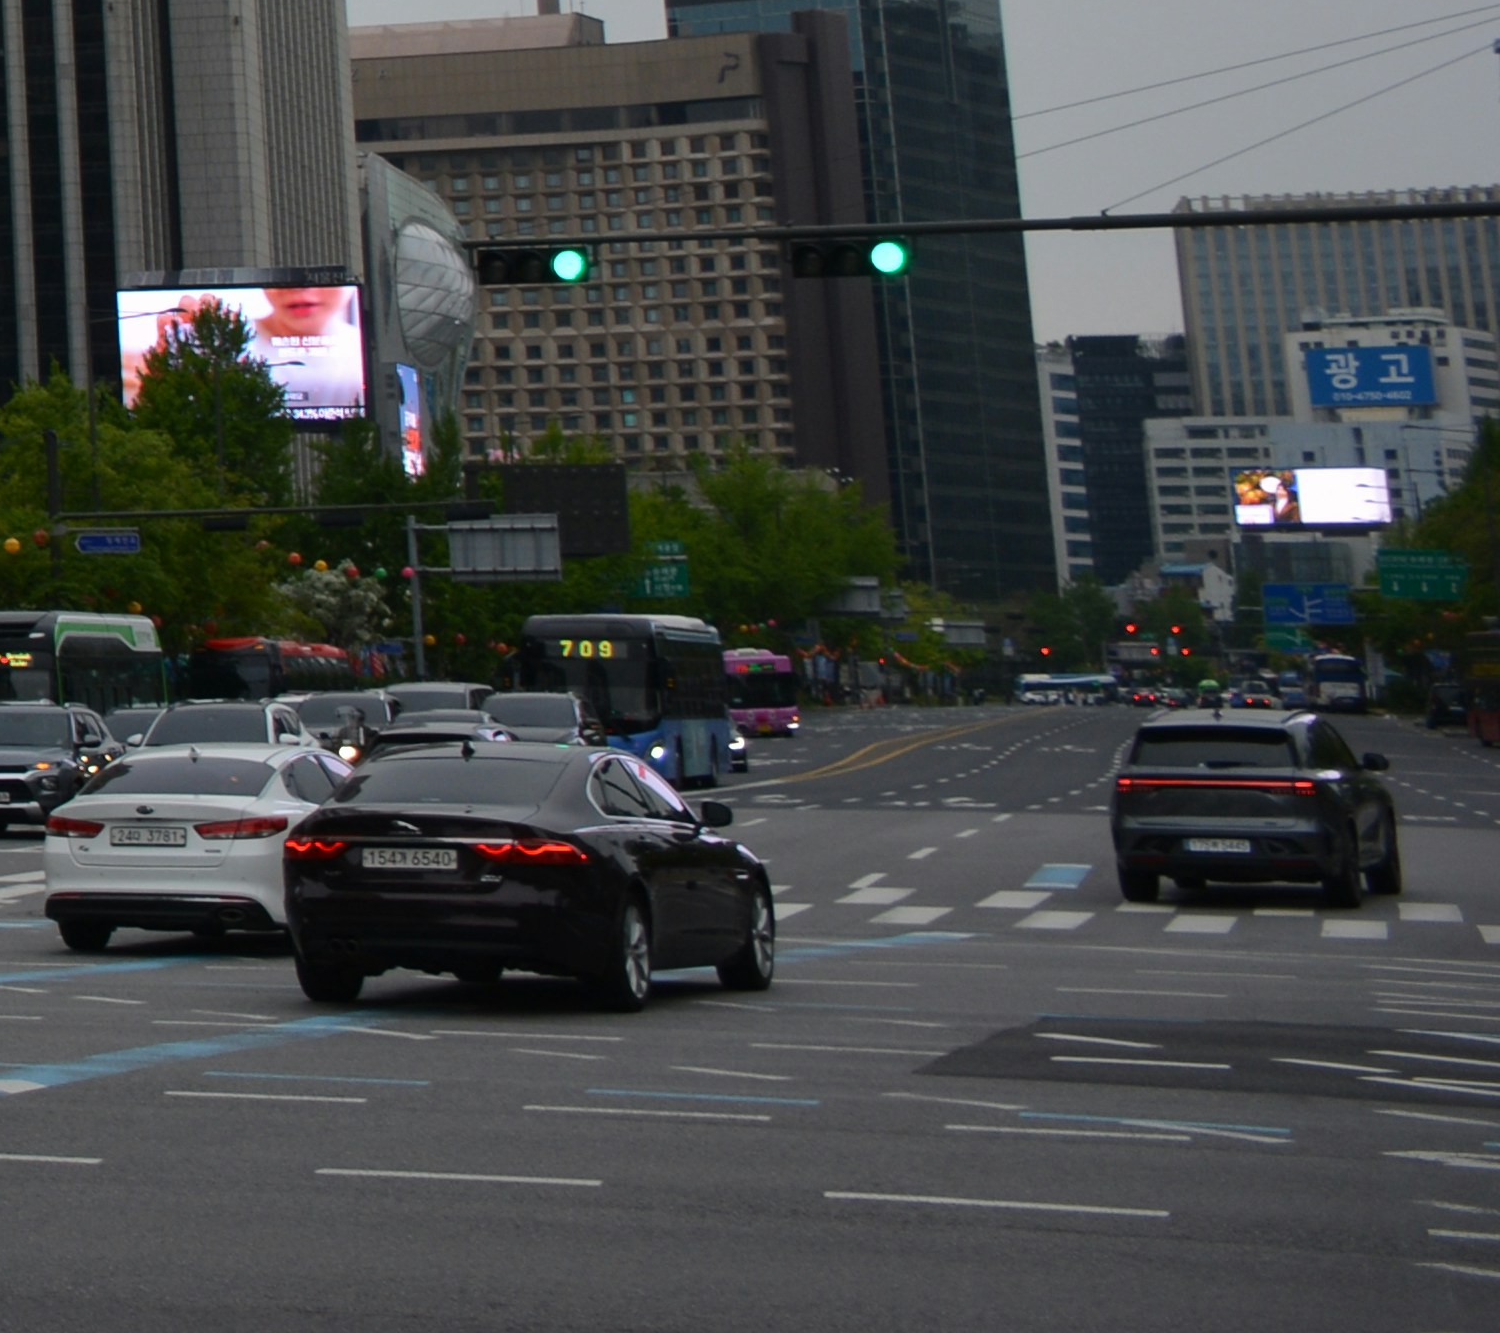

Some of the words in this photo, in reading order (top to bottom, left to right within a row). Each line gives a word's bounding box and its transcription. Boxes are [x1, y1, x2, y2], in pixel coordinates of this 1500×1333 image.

[1324, 353, 1415, 389] 광고
[559, 640, 612, 658] 709
[146, 829, 178, 842] 3781
[411, 851, 451, 866] 6540
